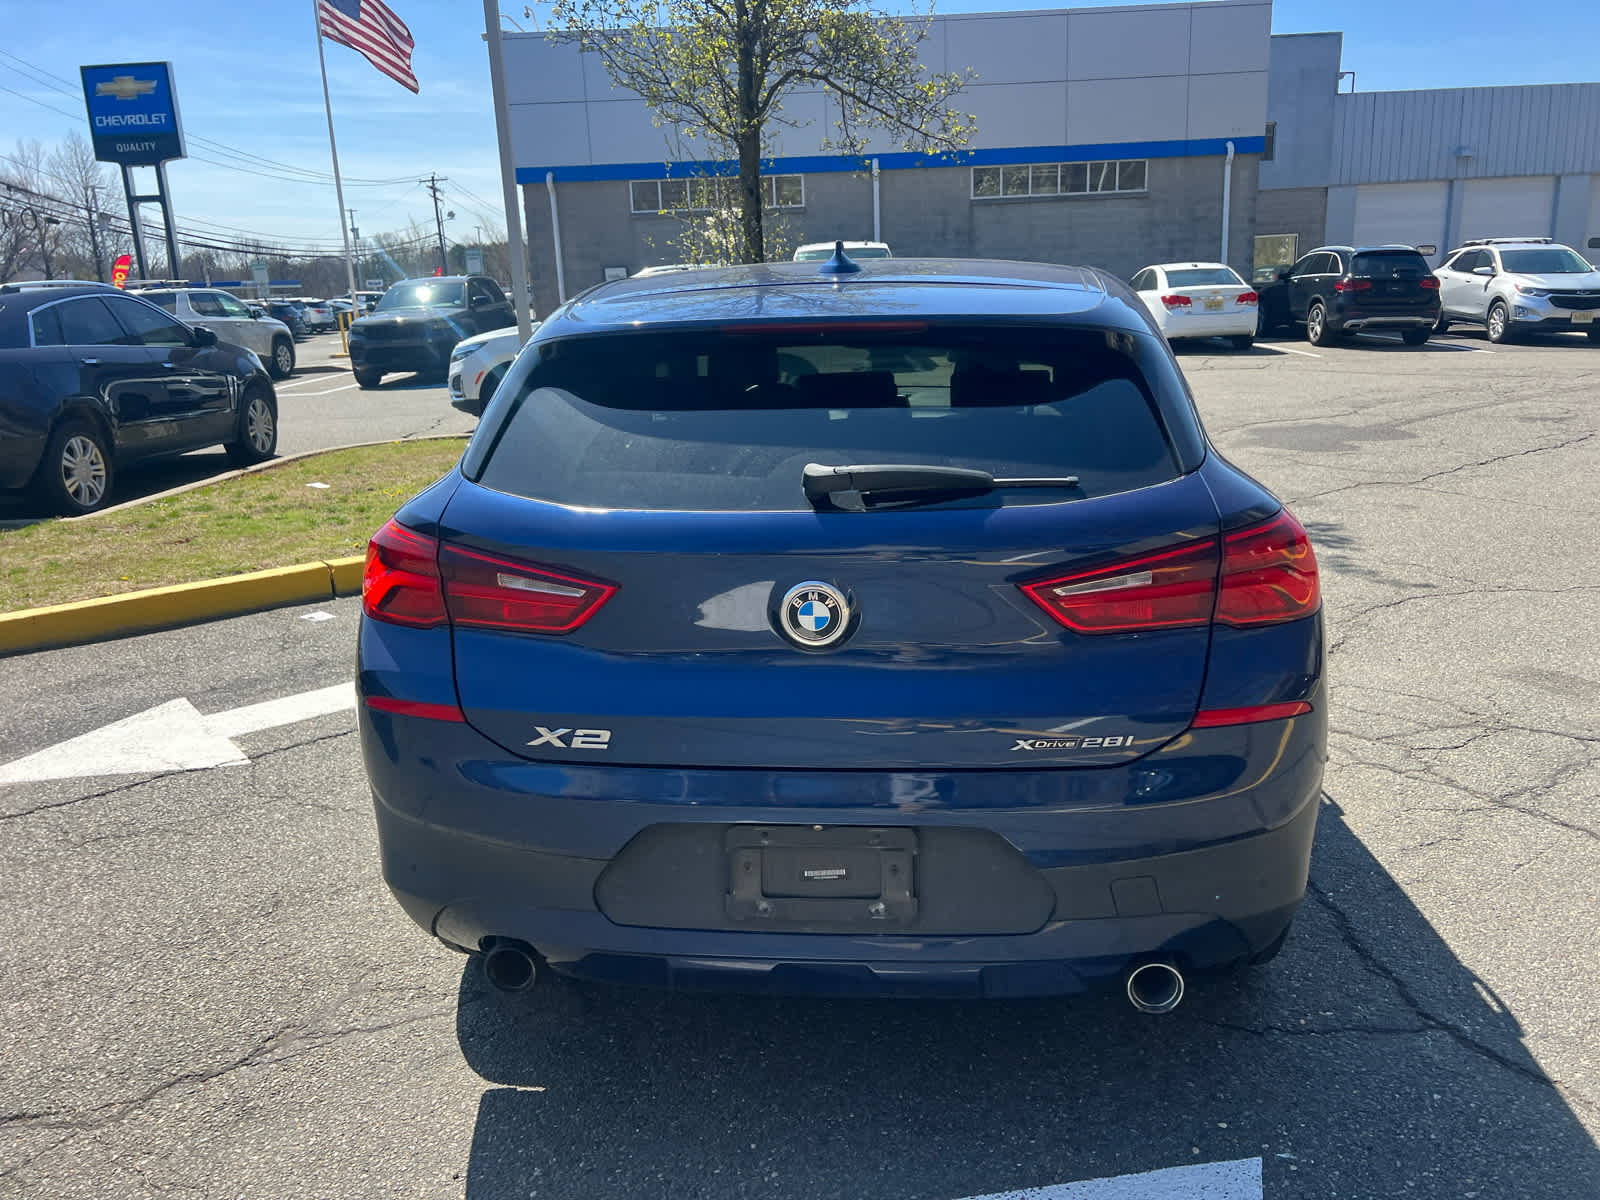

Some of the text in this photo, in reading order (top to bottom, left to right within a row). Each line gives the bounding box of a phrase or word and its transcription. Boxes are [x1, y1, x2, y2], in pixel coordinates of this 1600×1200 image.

[95, 113, 167, 127] CHEVROLET
[116, 142, 157, 153] QUALITY
[792, 591, 836, 609] BMW
[526, 726, 611, 750] X2
